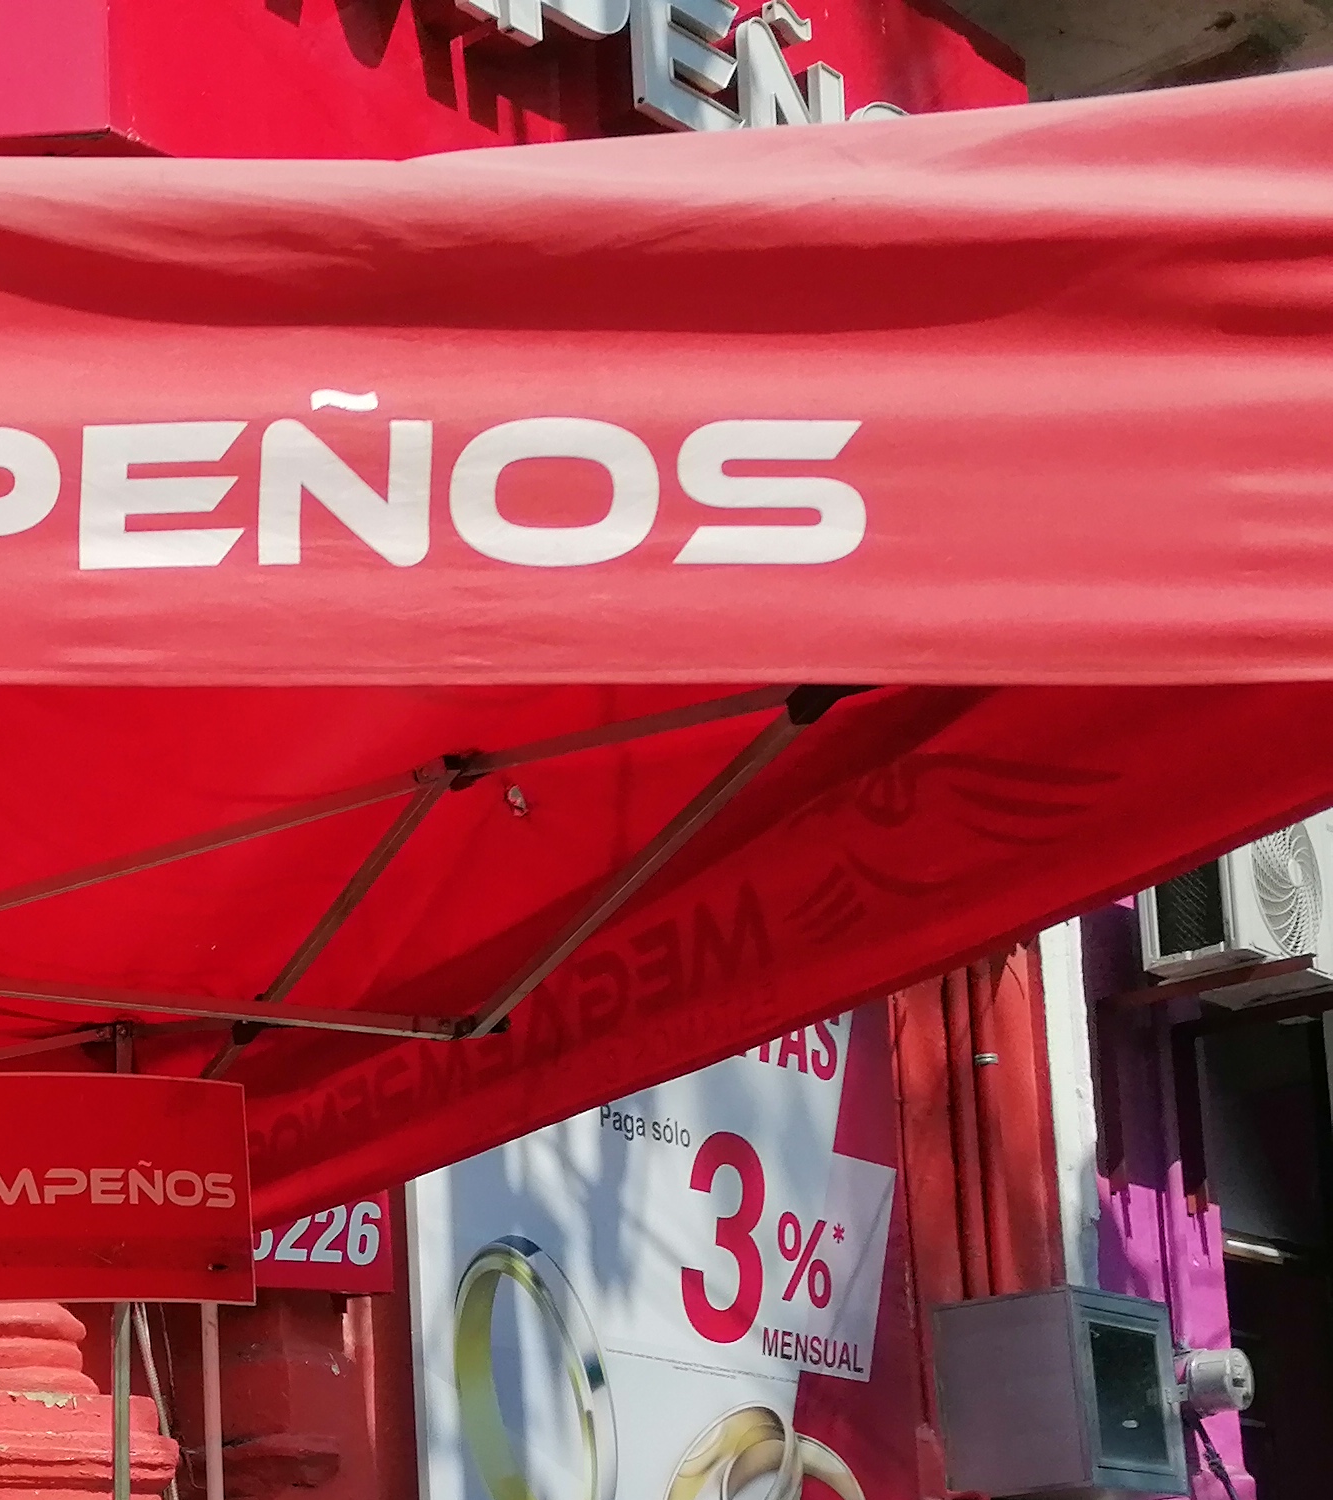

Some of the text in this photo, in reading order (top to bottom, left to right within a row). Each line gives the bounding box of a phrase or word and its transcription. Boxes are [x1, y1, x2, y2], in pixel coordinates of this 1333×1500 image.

[600, 1104, 691, 1148] Paga sólo
[762, 1328, 864, 1373] MENSUAL
